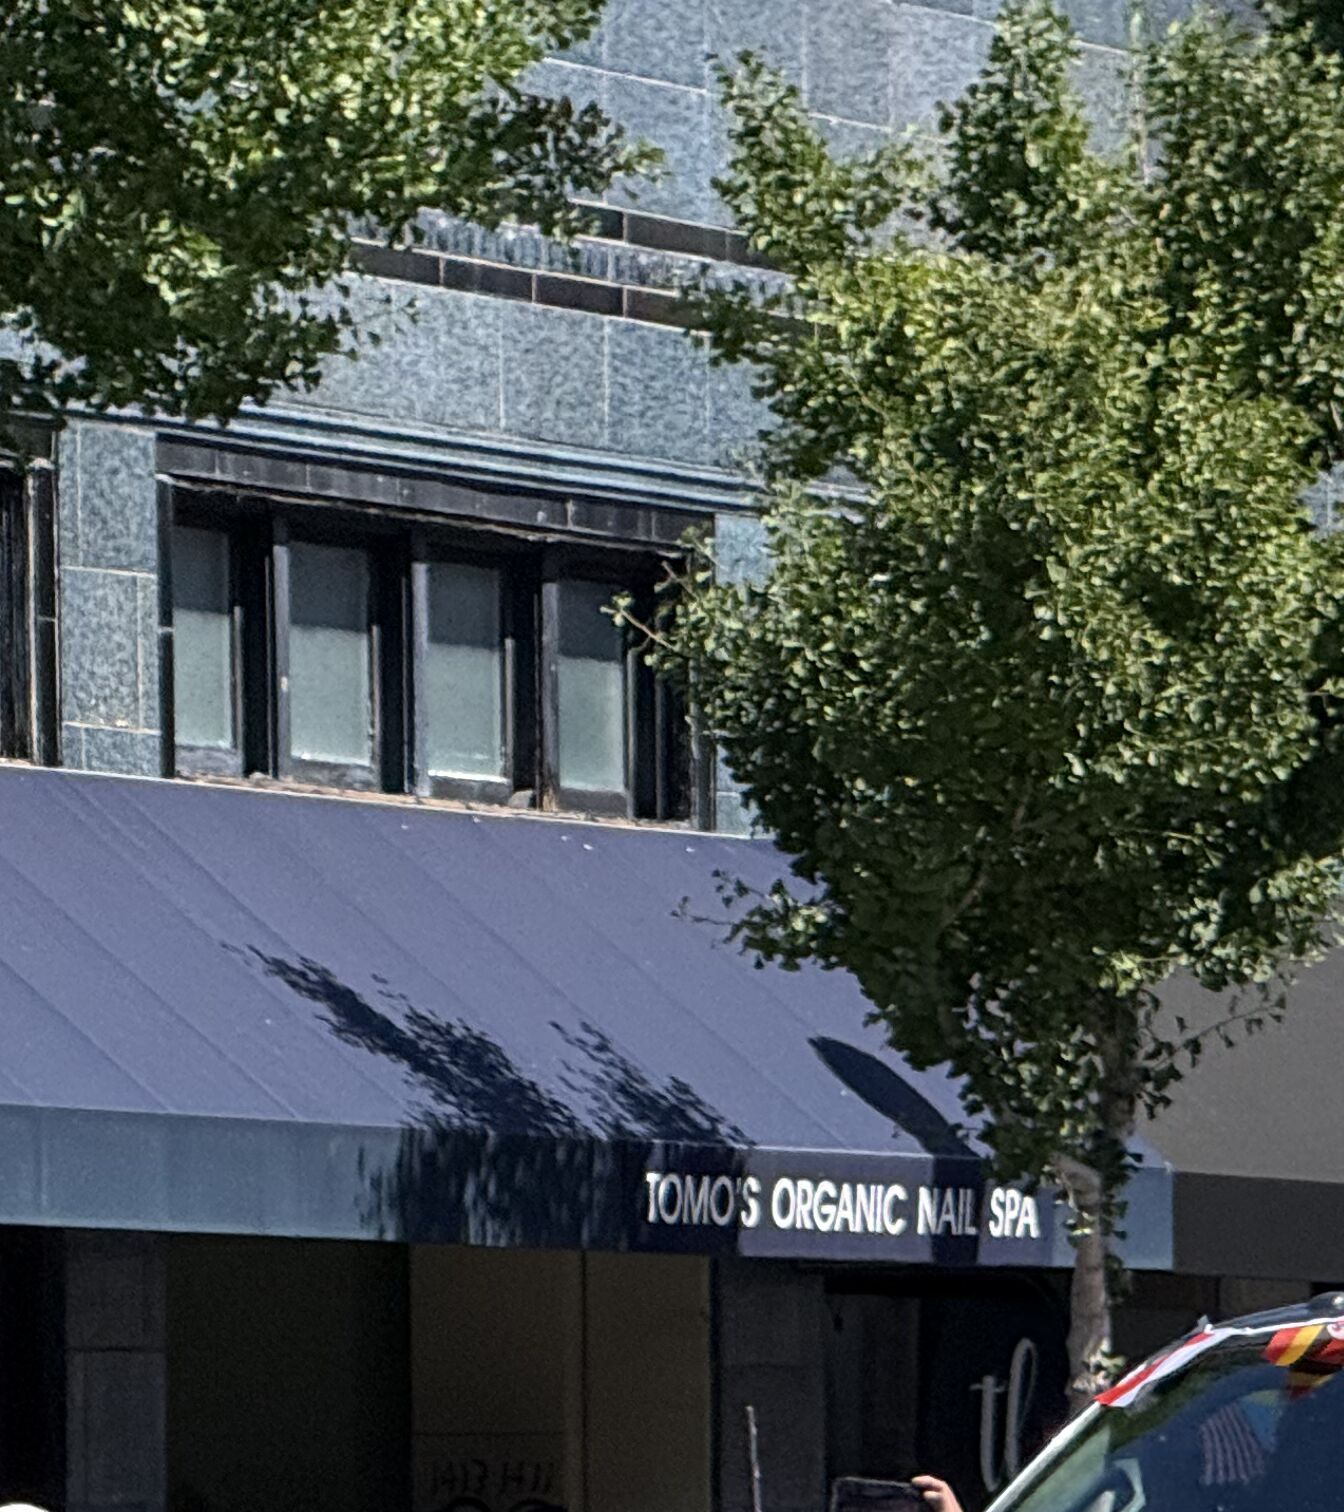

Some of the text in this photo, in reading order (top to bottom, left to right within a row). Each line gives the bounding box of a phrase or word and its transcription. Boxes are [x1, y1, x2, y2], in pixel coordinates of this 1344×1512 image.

[646, 1172, 1041, 1238] TOMO'S ORGANIC NAIL SPA
